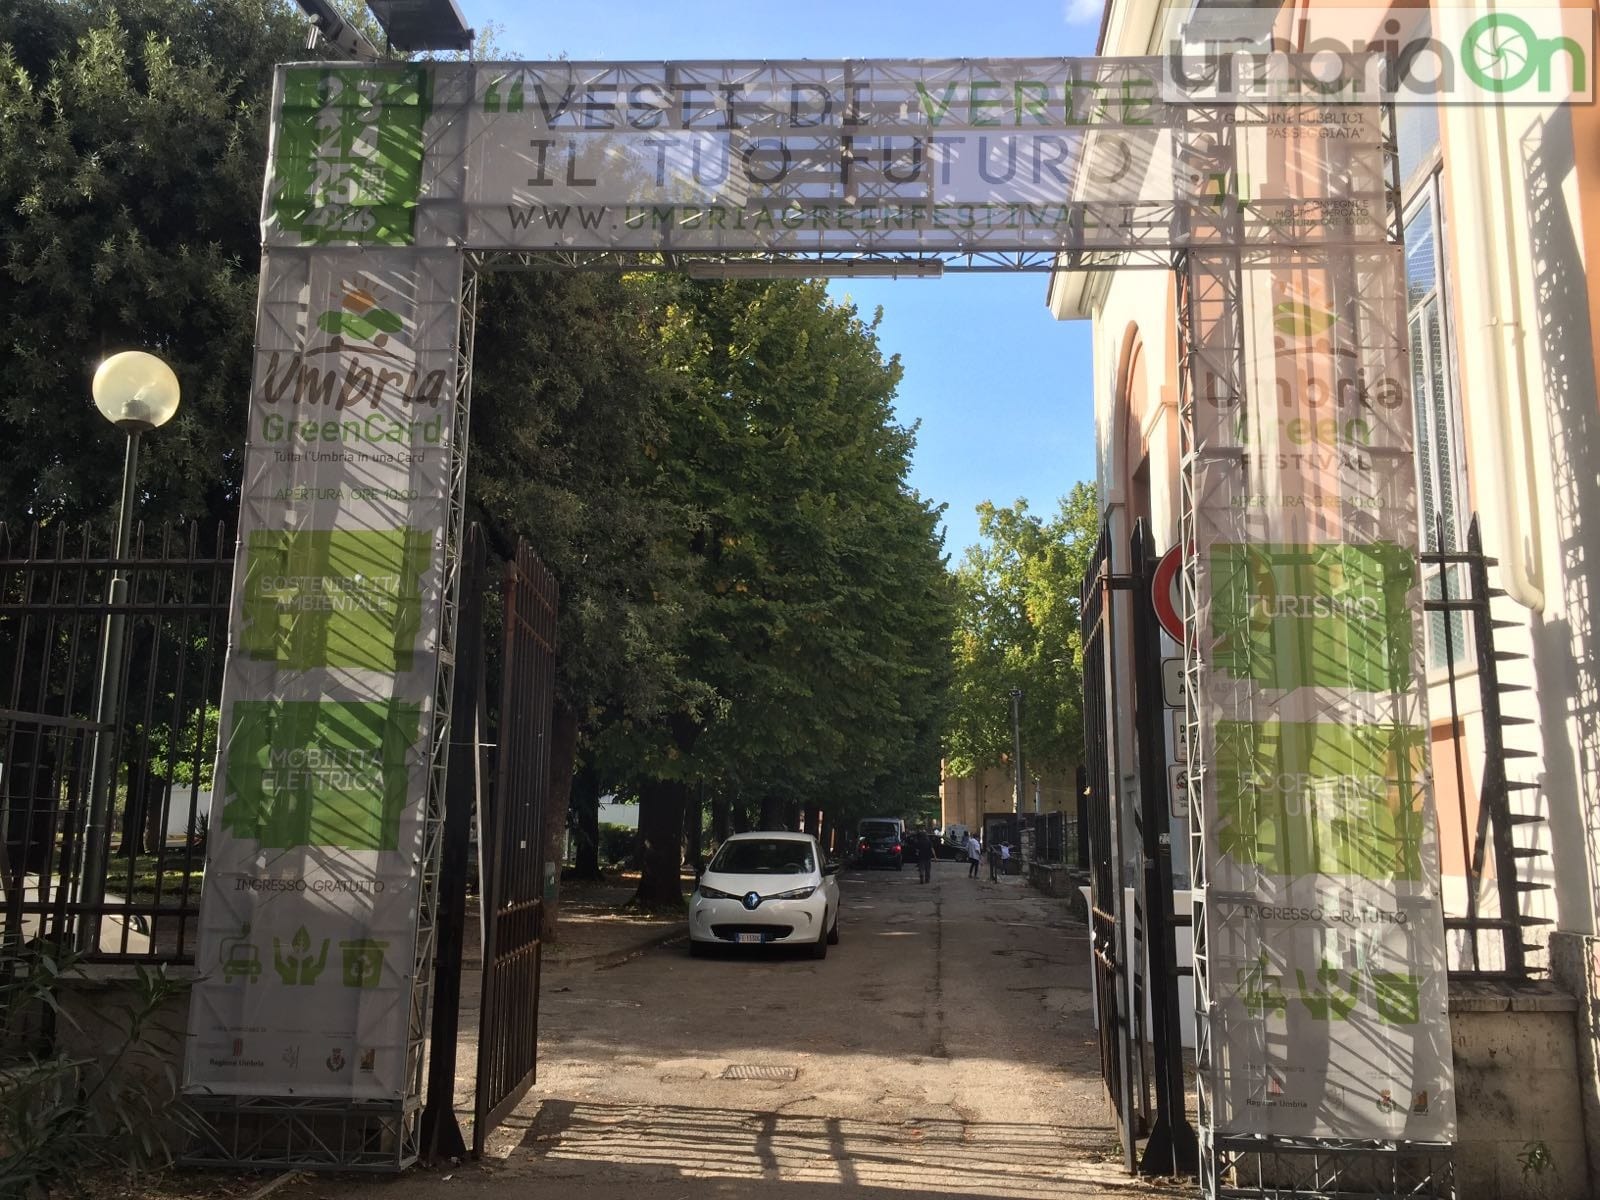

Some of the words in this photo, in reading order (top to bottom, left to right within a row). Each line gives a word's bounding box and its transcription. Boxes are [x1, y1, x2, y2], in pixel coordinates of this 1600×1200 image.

[790, 83, 870, 128] DI
[914, 79, 1154, 128] VERDE
[528, 139, 597, 186] IL
[643, 138, 792, 187] TUO
[841, 134, 1132, 185] FUTURO
[263, 352, 447, 411] Umbria
[261, 413, 442, 443] GreenCard
[358, 453, 369, 462] in
[372, 454, 393, 463] una
[398, 452, 425, 463] Card
[275, 488, 344, 500] APERTURA
[1242, 594, 1379, 618] TURISMO
[262, 770, 385, 791] ELETTRICA
[234, 878, 307, 892] INGRESSO
[312, 879, 385, 894] GRATUITO
[1243, 906, 1323, 921] INGRESSO
